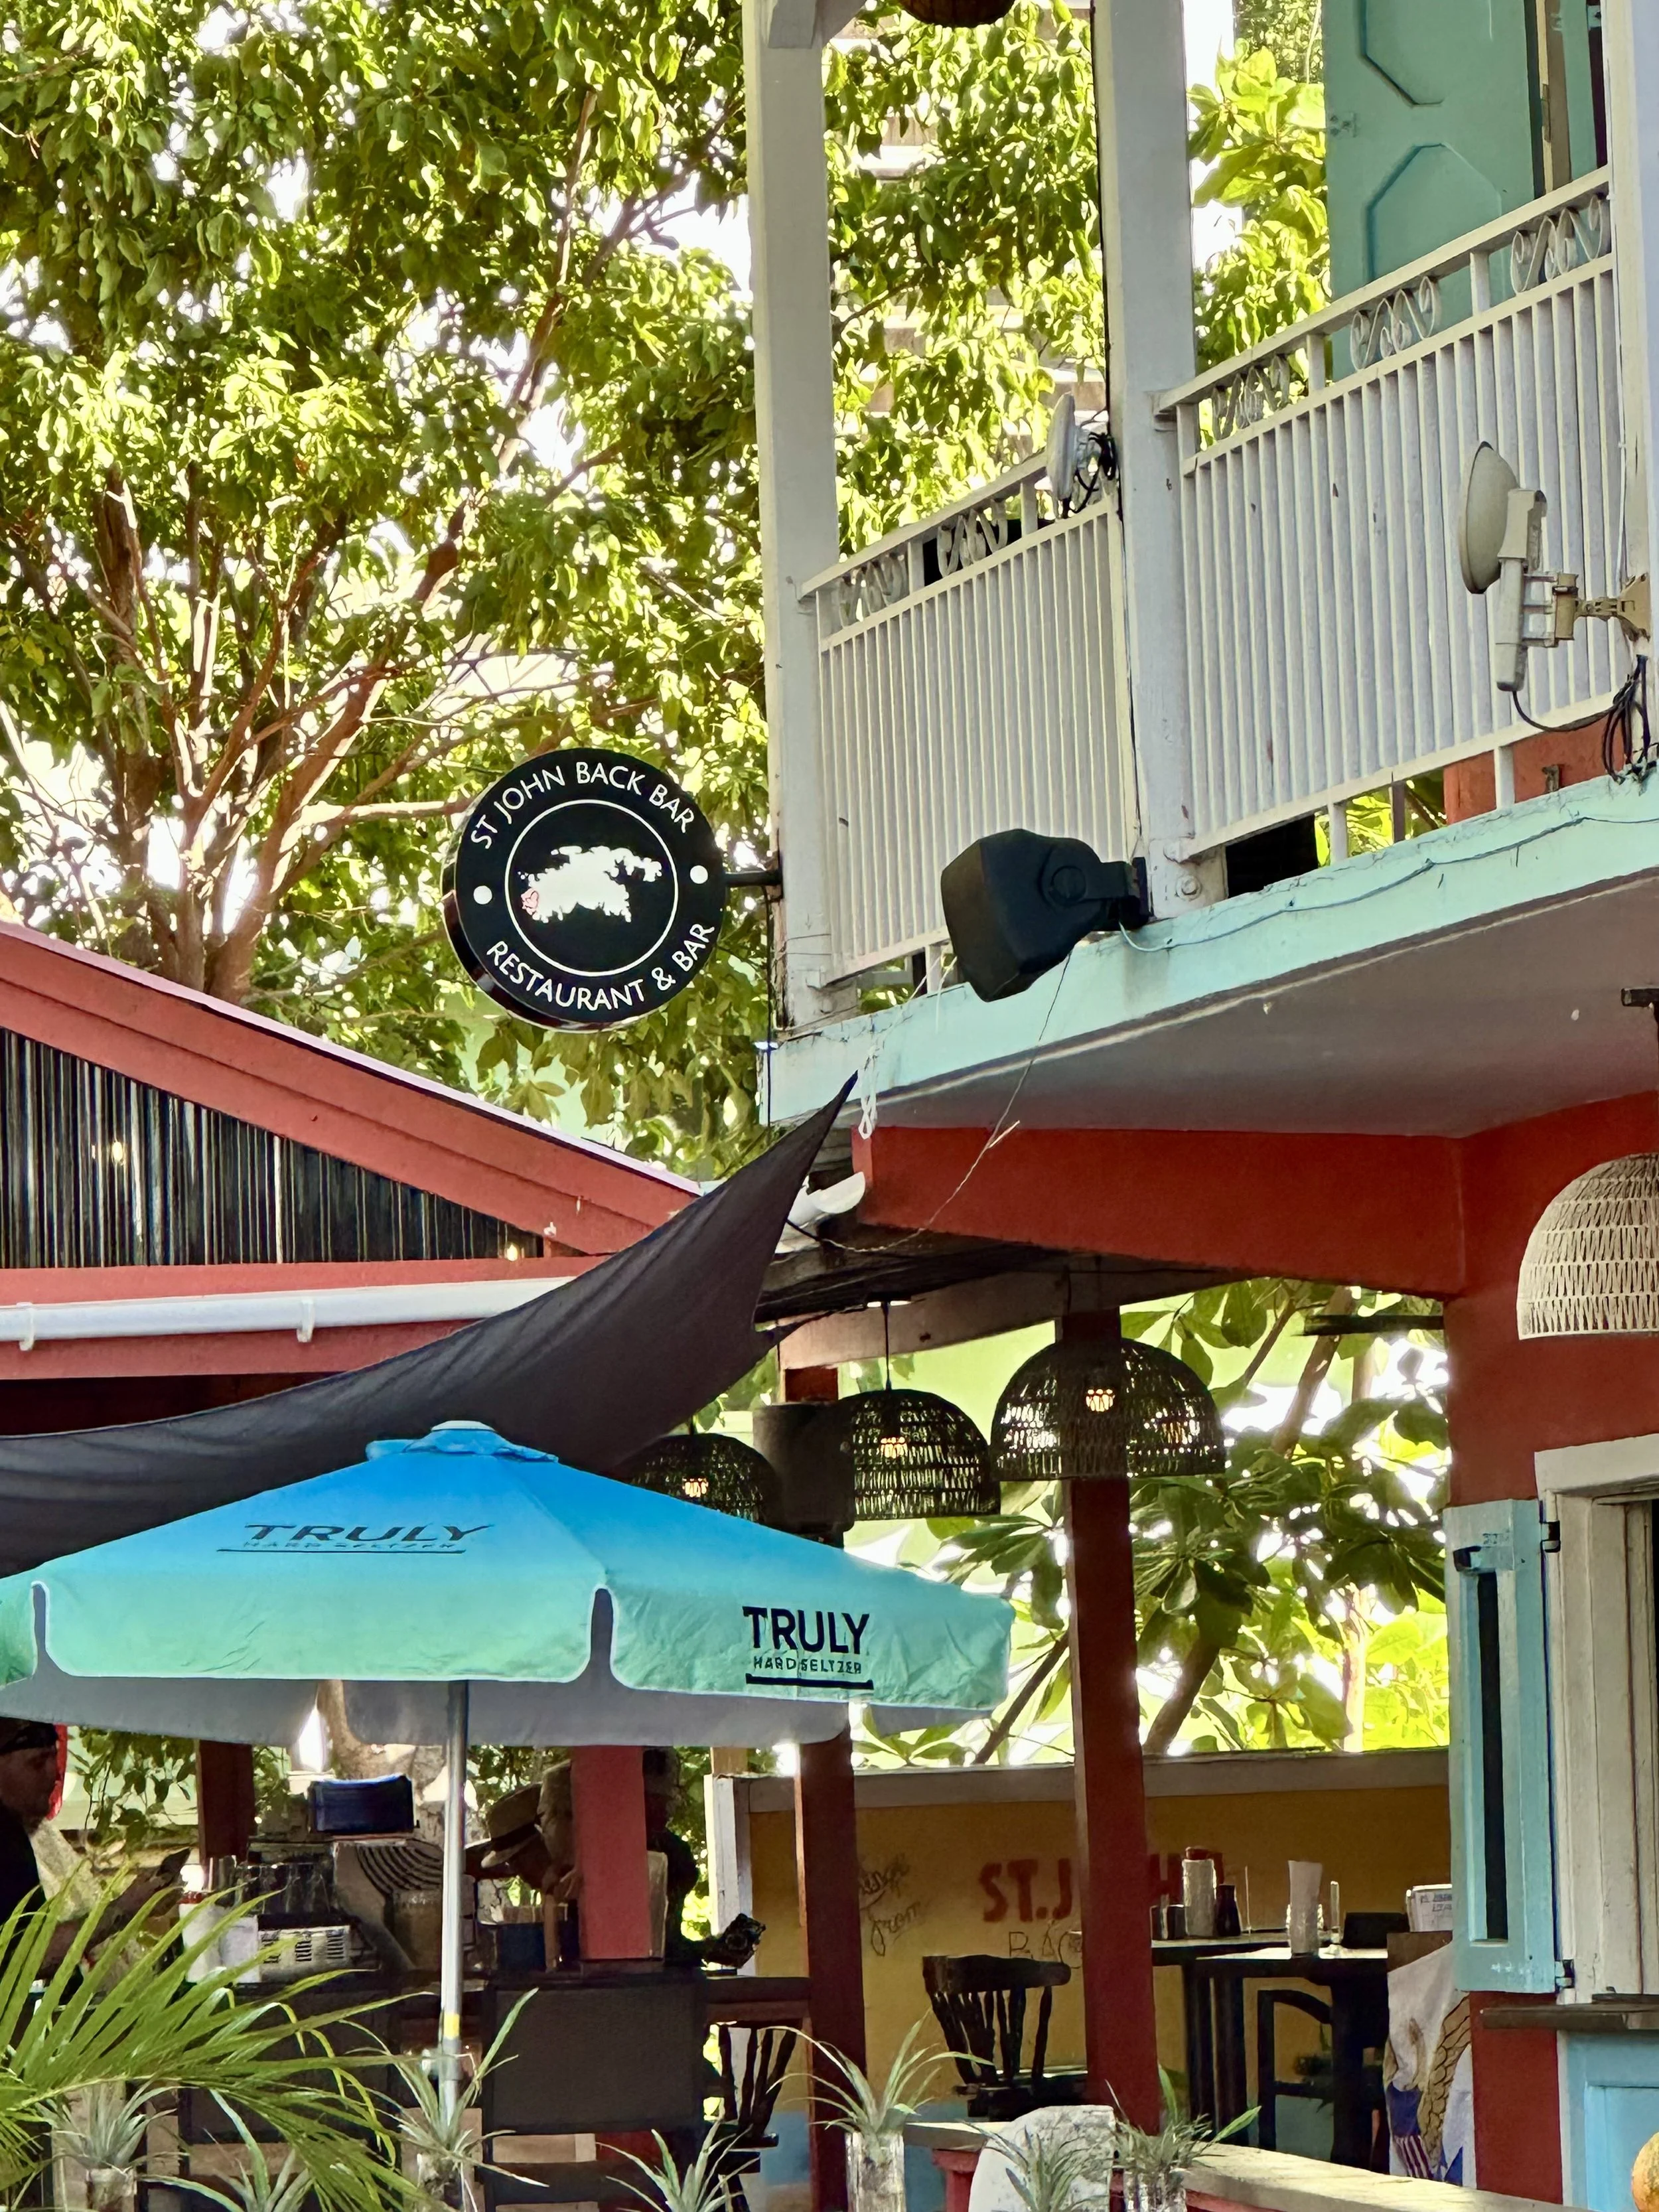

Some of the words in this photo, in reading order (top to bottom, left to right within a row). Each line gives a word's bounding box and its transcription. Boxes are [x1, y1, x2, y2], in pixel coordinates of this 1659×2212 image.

[470, 814, 498, 849] ST
[493, 765, 565, 825] JOHN
[575, 761, 646, 796] BACK
[648, 784, 695, 834] BAR
[486, 940, 645, 1011] RESTAURANT
[651, 966, 677, 991] &
[672, 923, 715, 972] BAR
[244, 1523, 496, 1542] TRULY
[741, 1605, 871, 1655] TRULY
